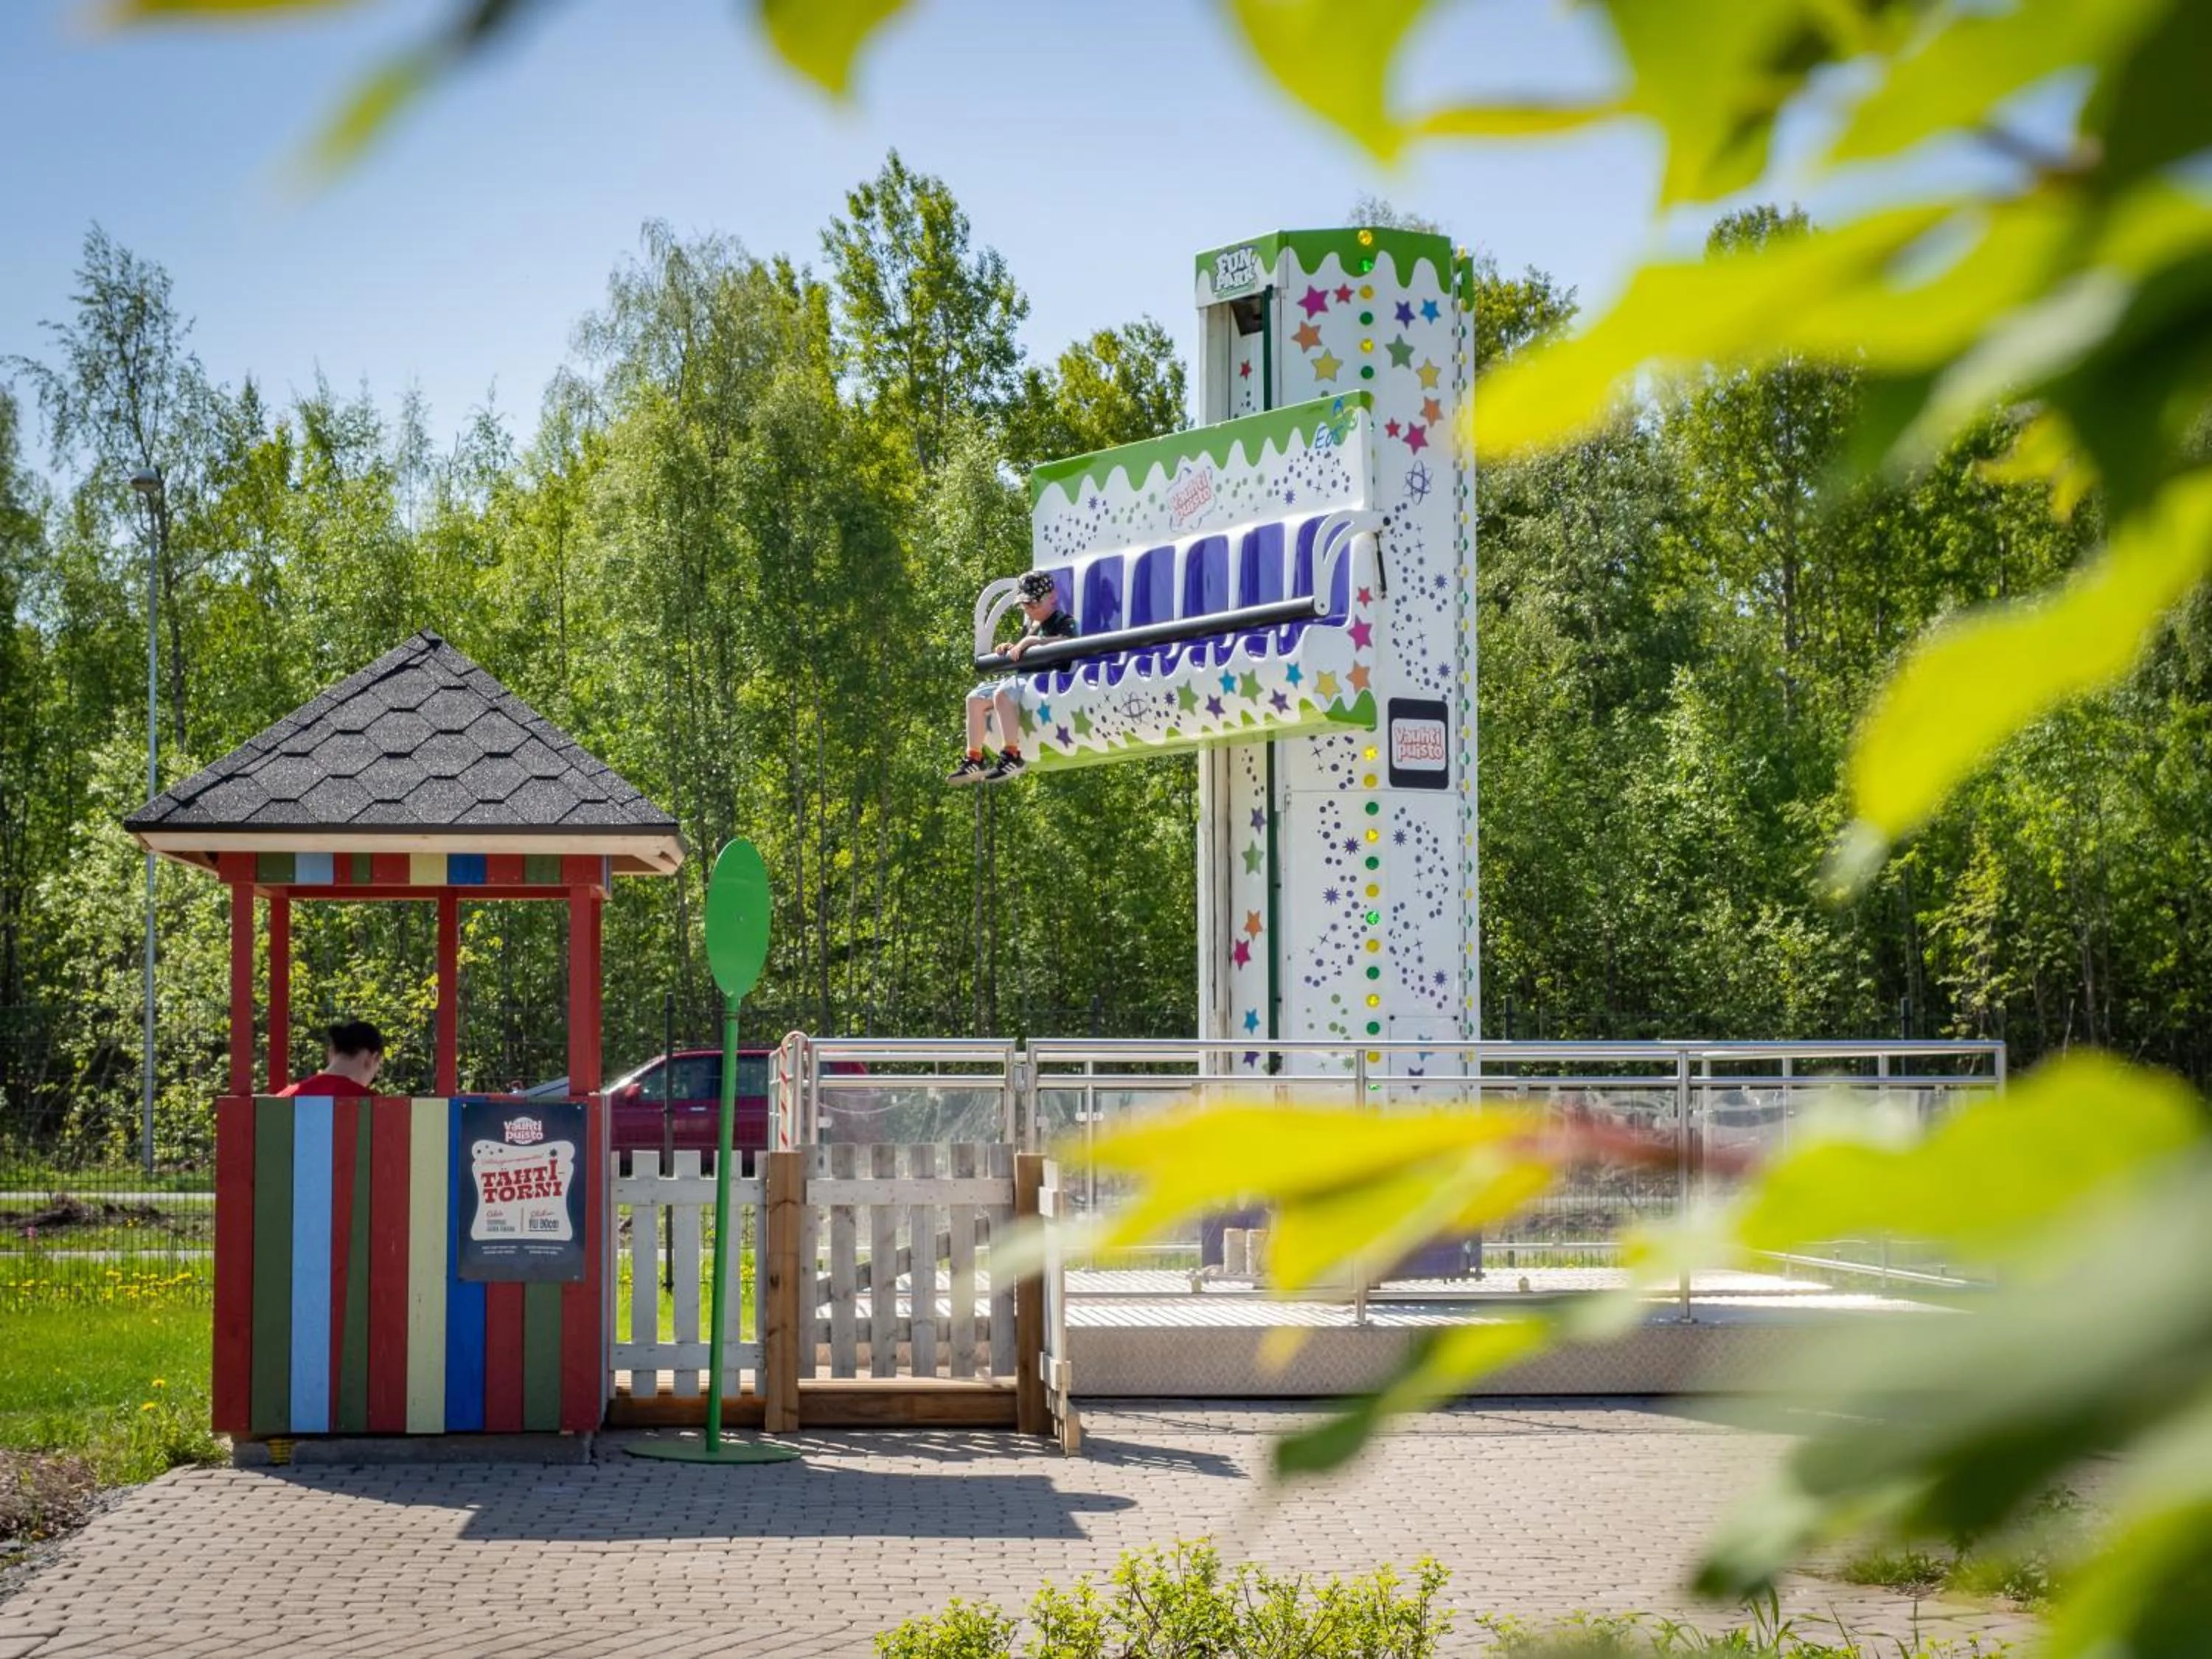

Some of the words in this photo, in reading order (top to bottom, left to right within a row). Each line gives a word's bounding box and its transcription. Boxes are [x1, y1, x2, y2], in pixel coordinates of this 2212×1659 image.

[1217, 248, 1253, 274] FUN
[1216, 268, 1255, 291] PARK
[1394, 727, 1442, 744] Vauhti
[1397, 742, 1444, 761] puisto
[505, 1131, 543, 1143] puisto
[483, 1181, 562, 1203] TORNI
